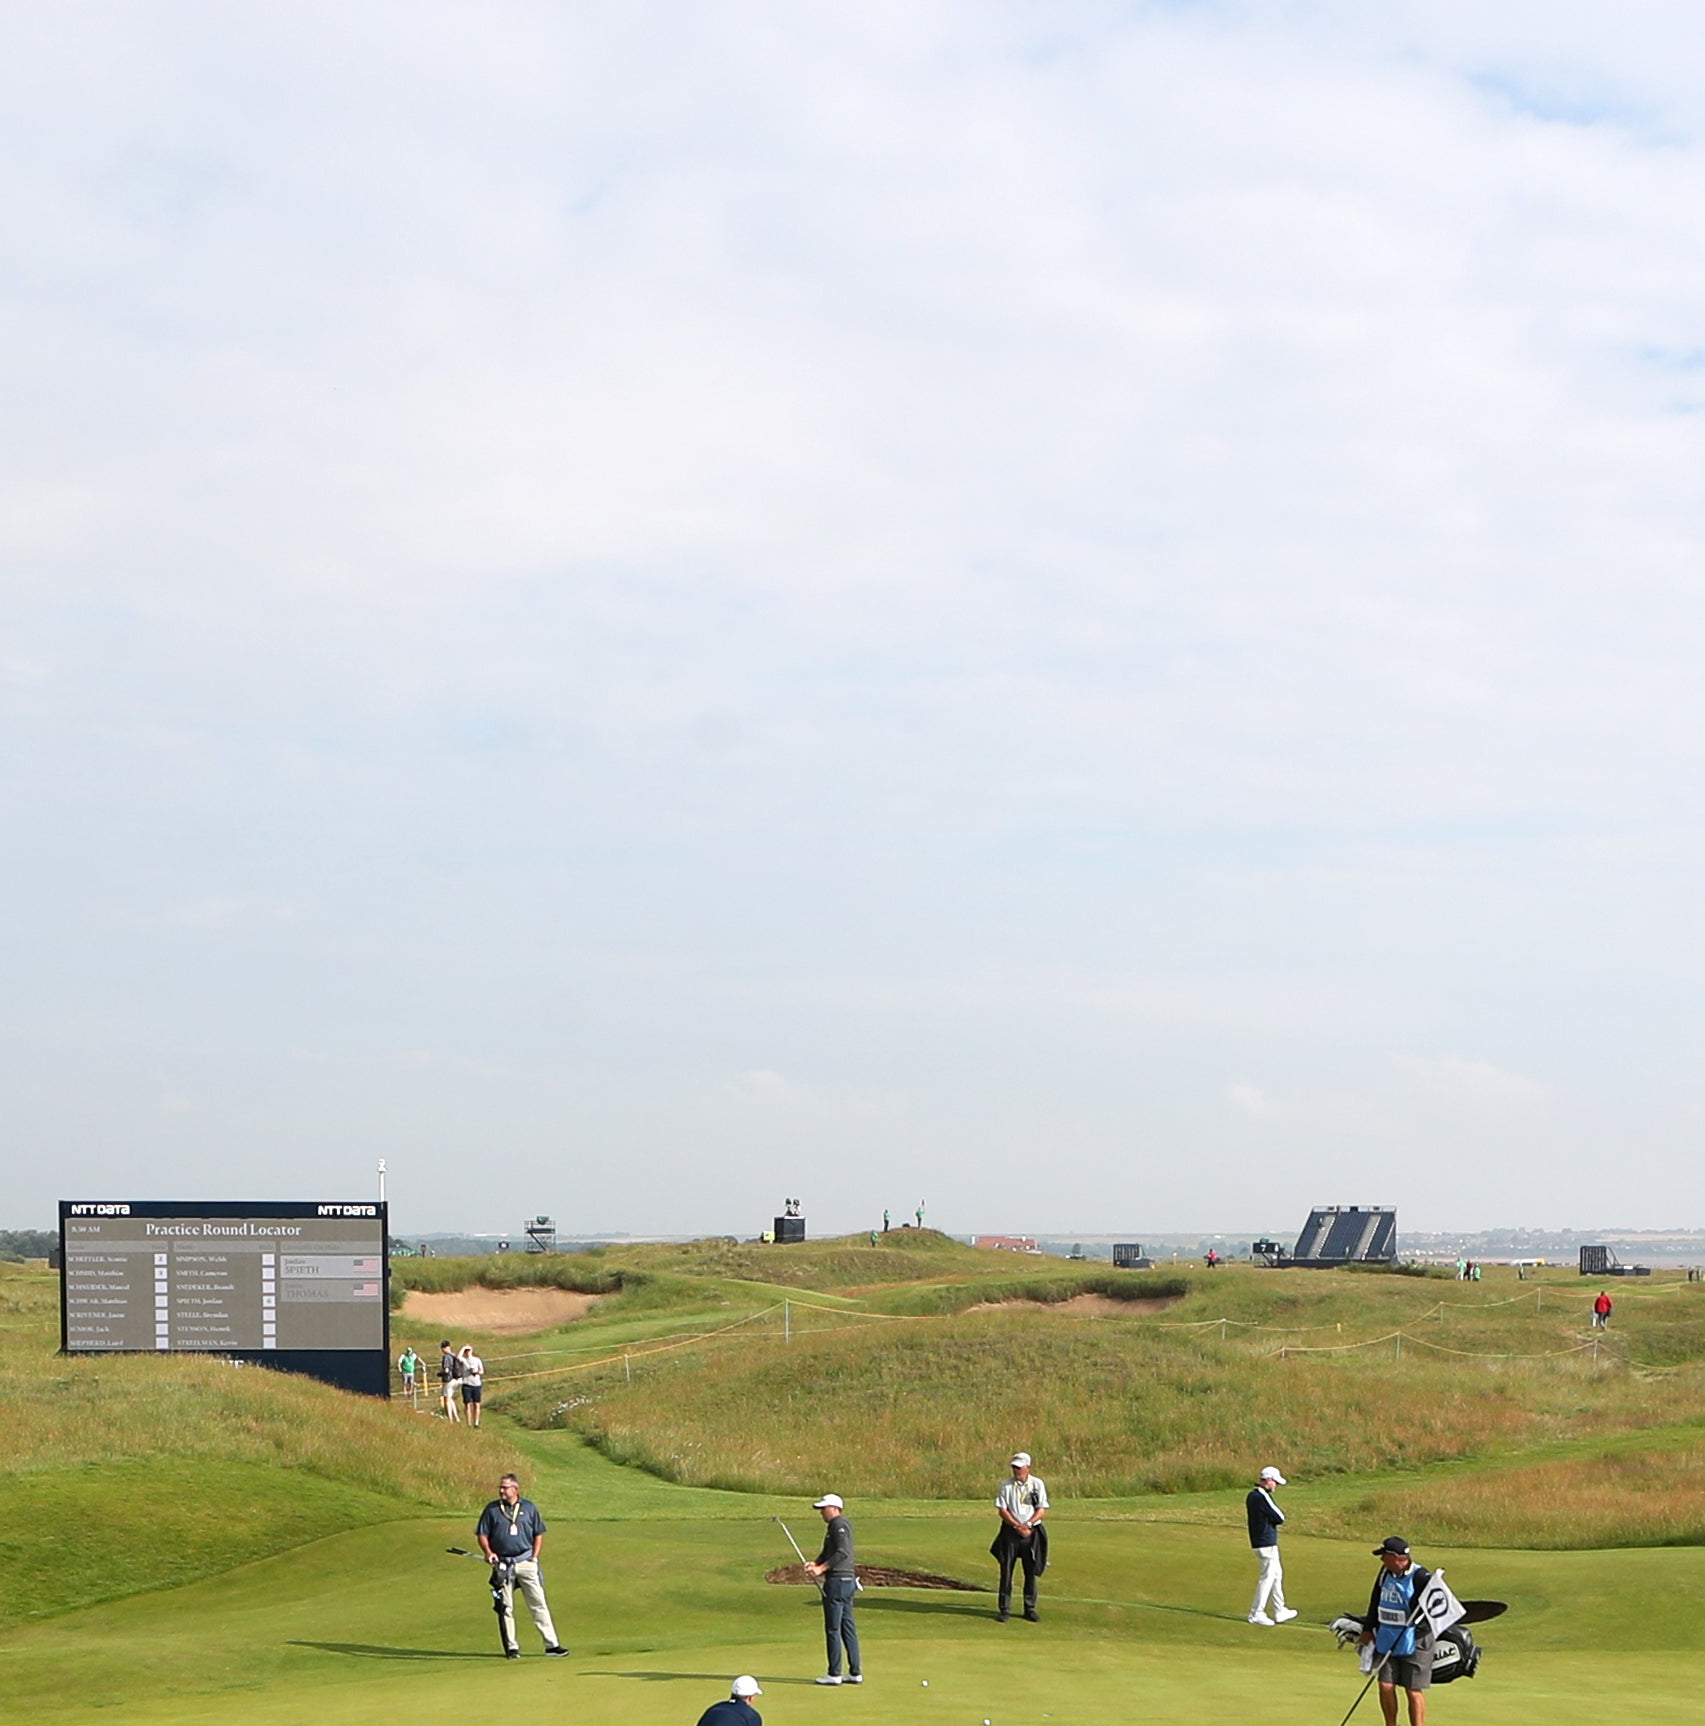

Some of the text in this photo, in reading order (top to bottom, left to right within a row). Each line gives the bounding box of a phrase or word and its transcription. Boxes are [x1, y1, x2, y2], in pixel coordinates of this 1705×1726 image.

[71, 1204, 96, 1215] NTT
[317, 1205, 342, 1215] NTT
[146, 1223, 302, 1236] Practice Round Locator
[284, 1266, 319, 1275] SPIETH
